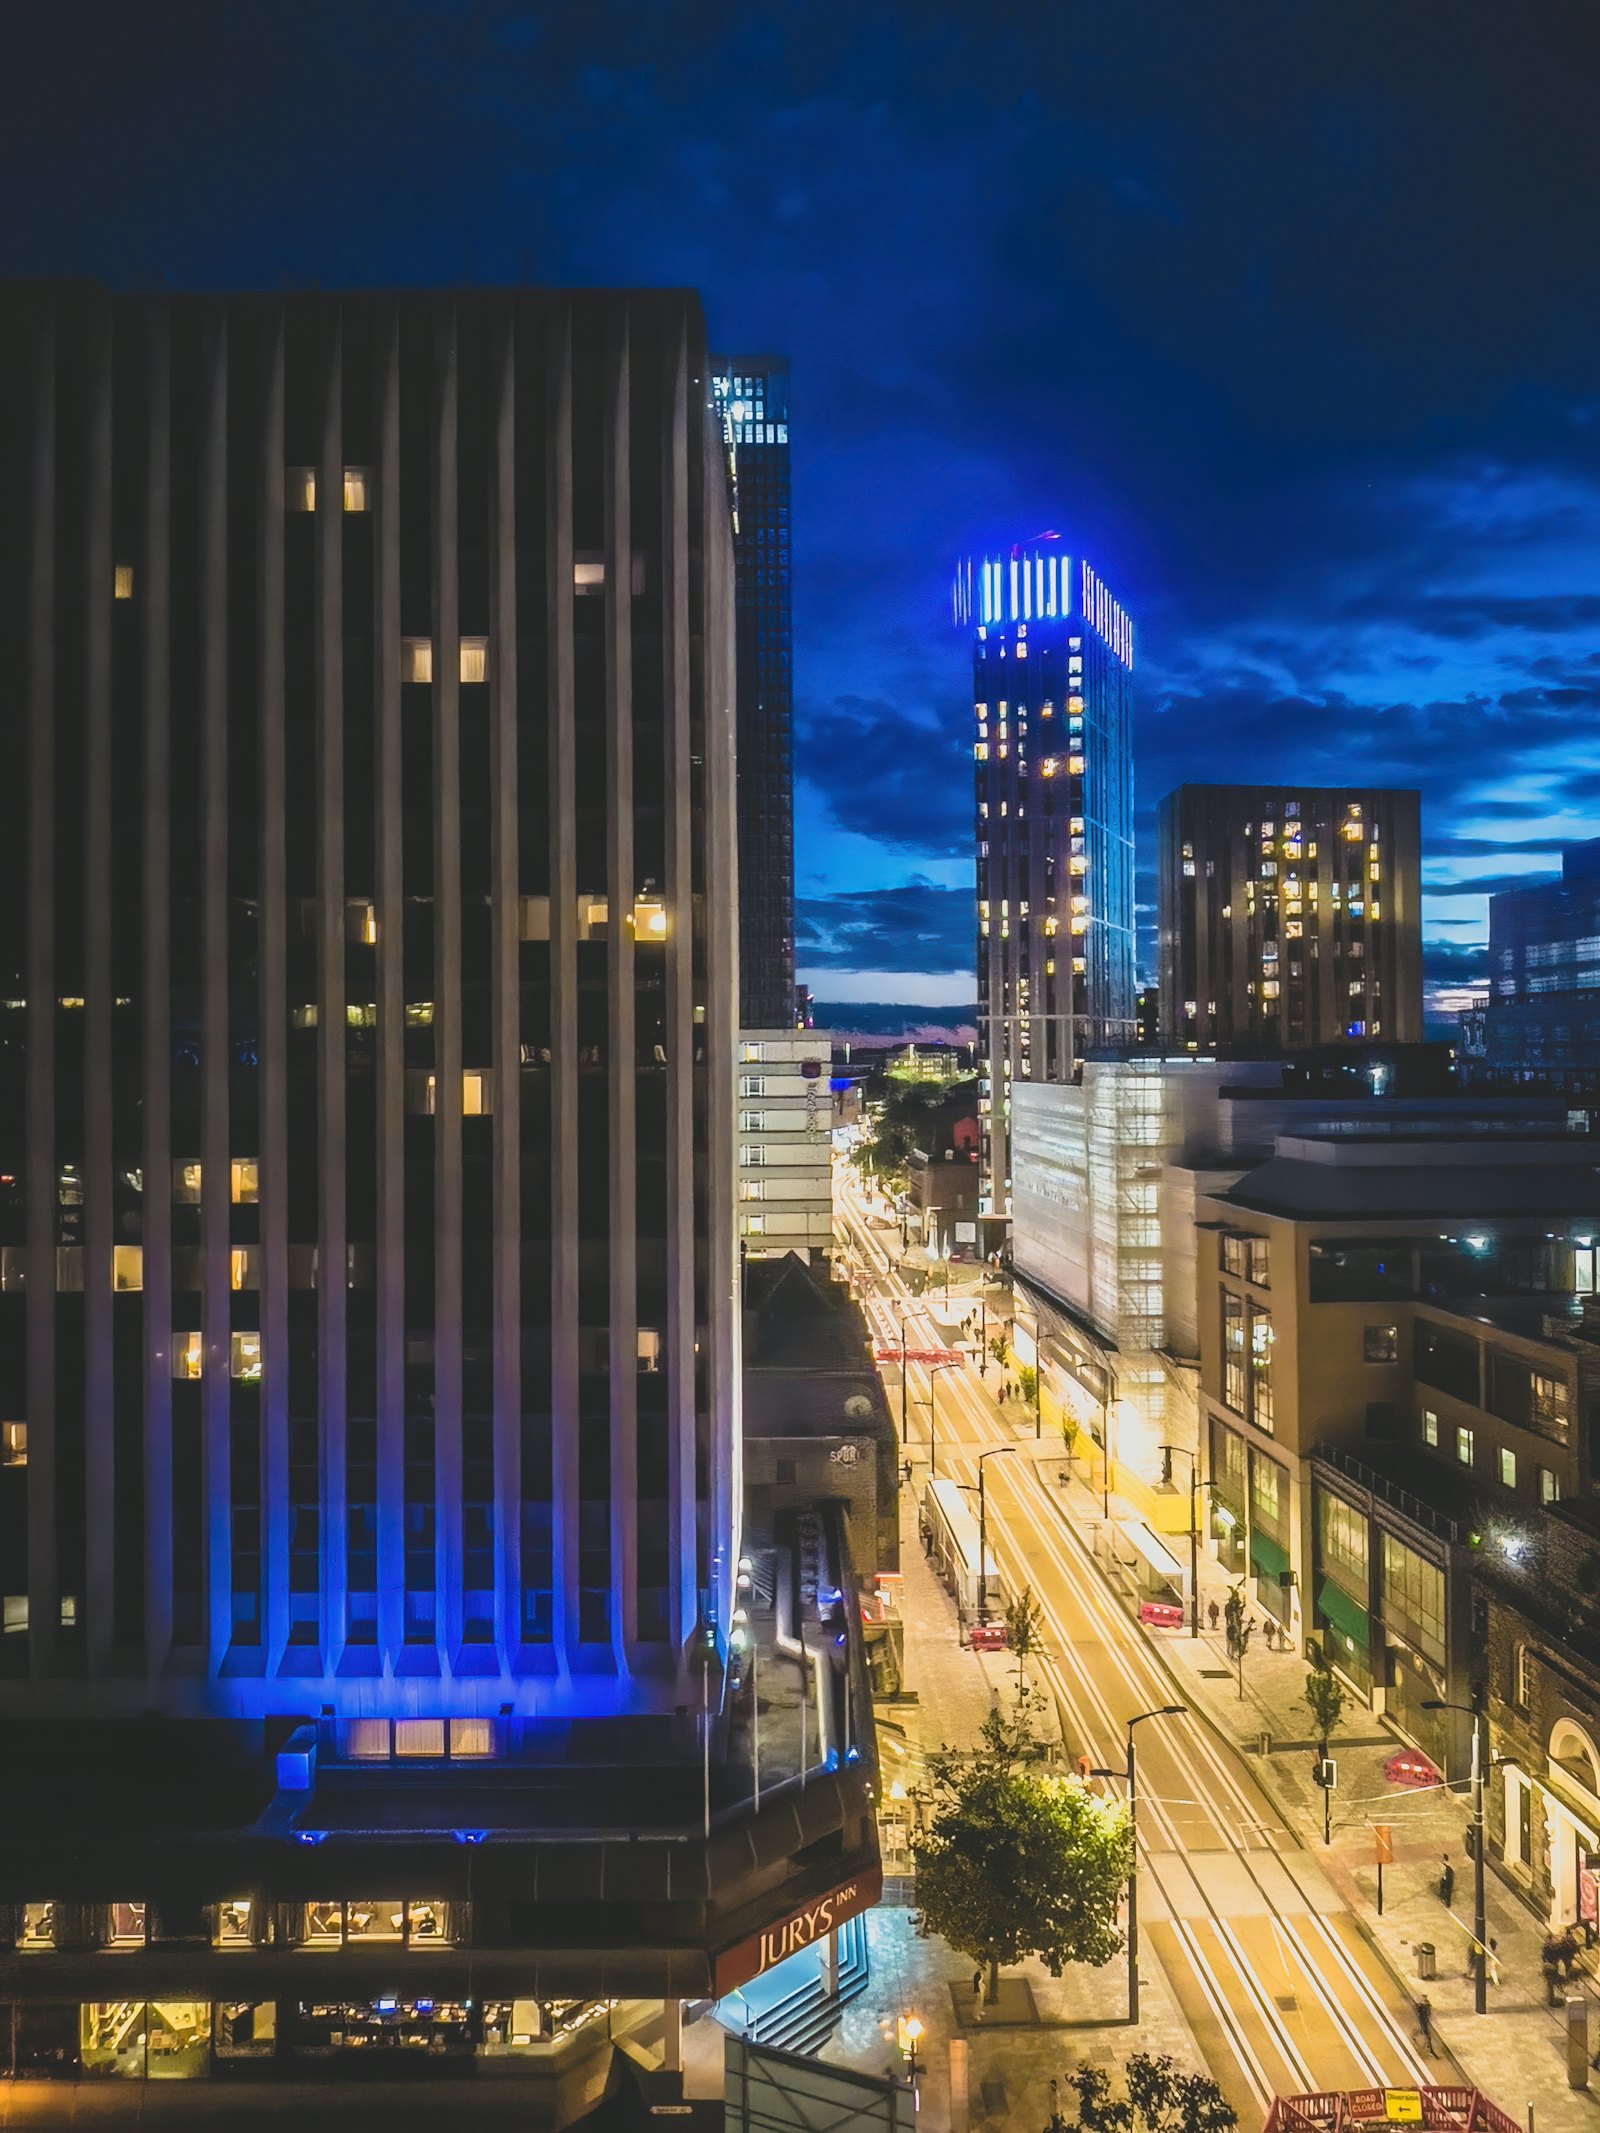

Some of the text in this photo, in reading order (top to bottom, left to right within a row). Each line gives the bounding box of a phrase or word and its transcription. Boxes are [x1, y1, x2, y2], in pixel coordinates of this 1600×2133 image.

[752, 1884, 857, 1976] JURYS INN
[1355, 2094, 1376, 2104] ROAD
[1352, 2102, 1383, 2113] CLOSED
